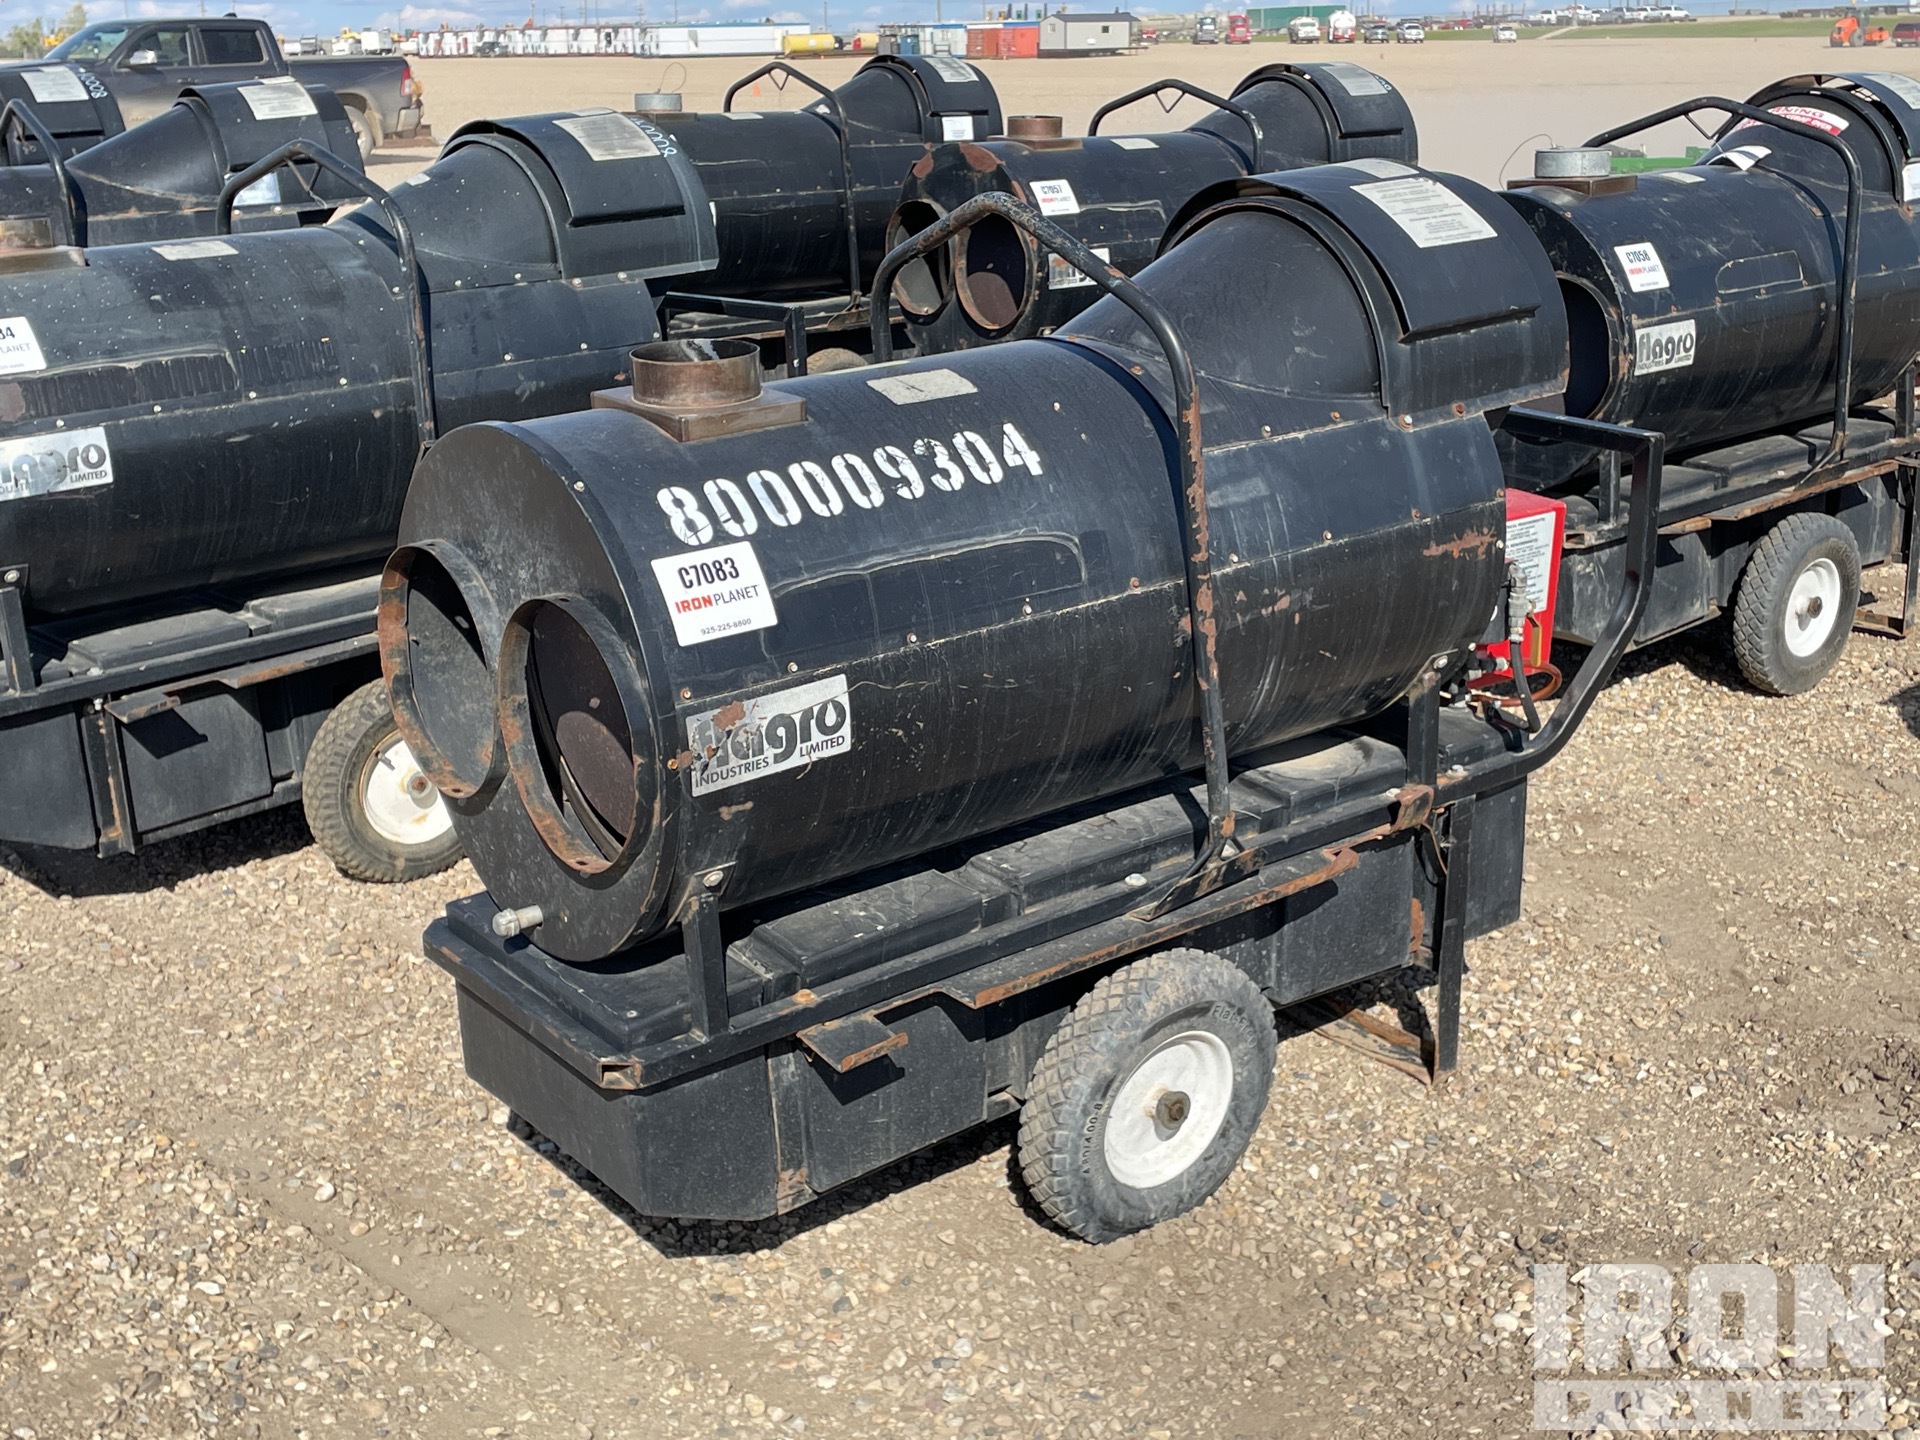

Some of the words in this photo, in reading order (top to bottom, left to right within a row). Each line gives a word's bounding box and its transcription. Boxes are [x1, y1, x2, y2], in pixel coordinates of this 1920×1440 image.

[1625, 249, 1651, 264] C7058
[1637, 332, 1695, 365] flagro
[70, 469, 108, 484] LIMITED
[656, 422, 1044, 547] 800009304
[677, 557, 740, 589] C7083
[700, 618, 752, 636] 925-225-8800
[694, 756, 770, 789] INDUSTRIES
[799, 735, 845, 758] LIMITED
